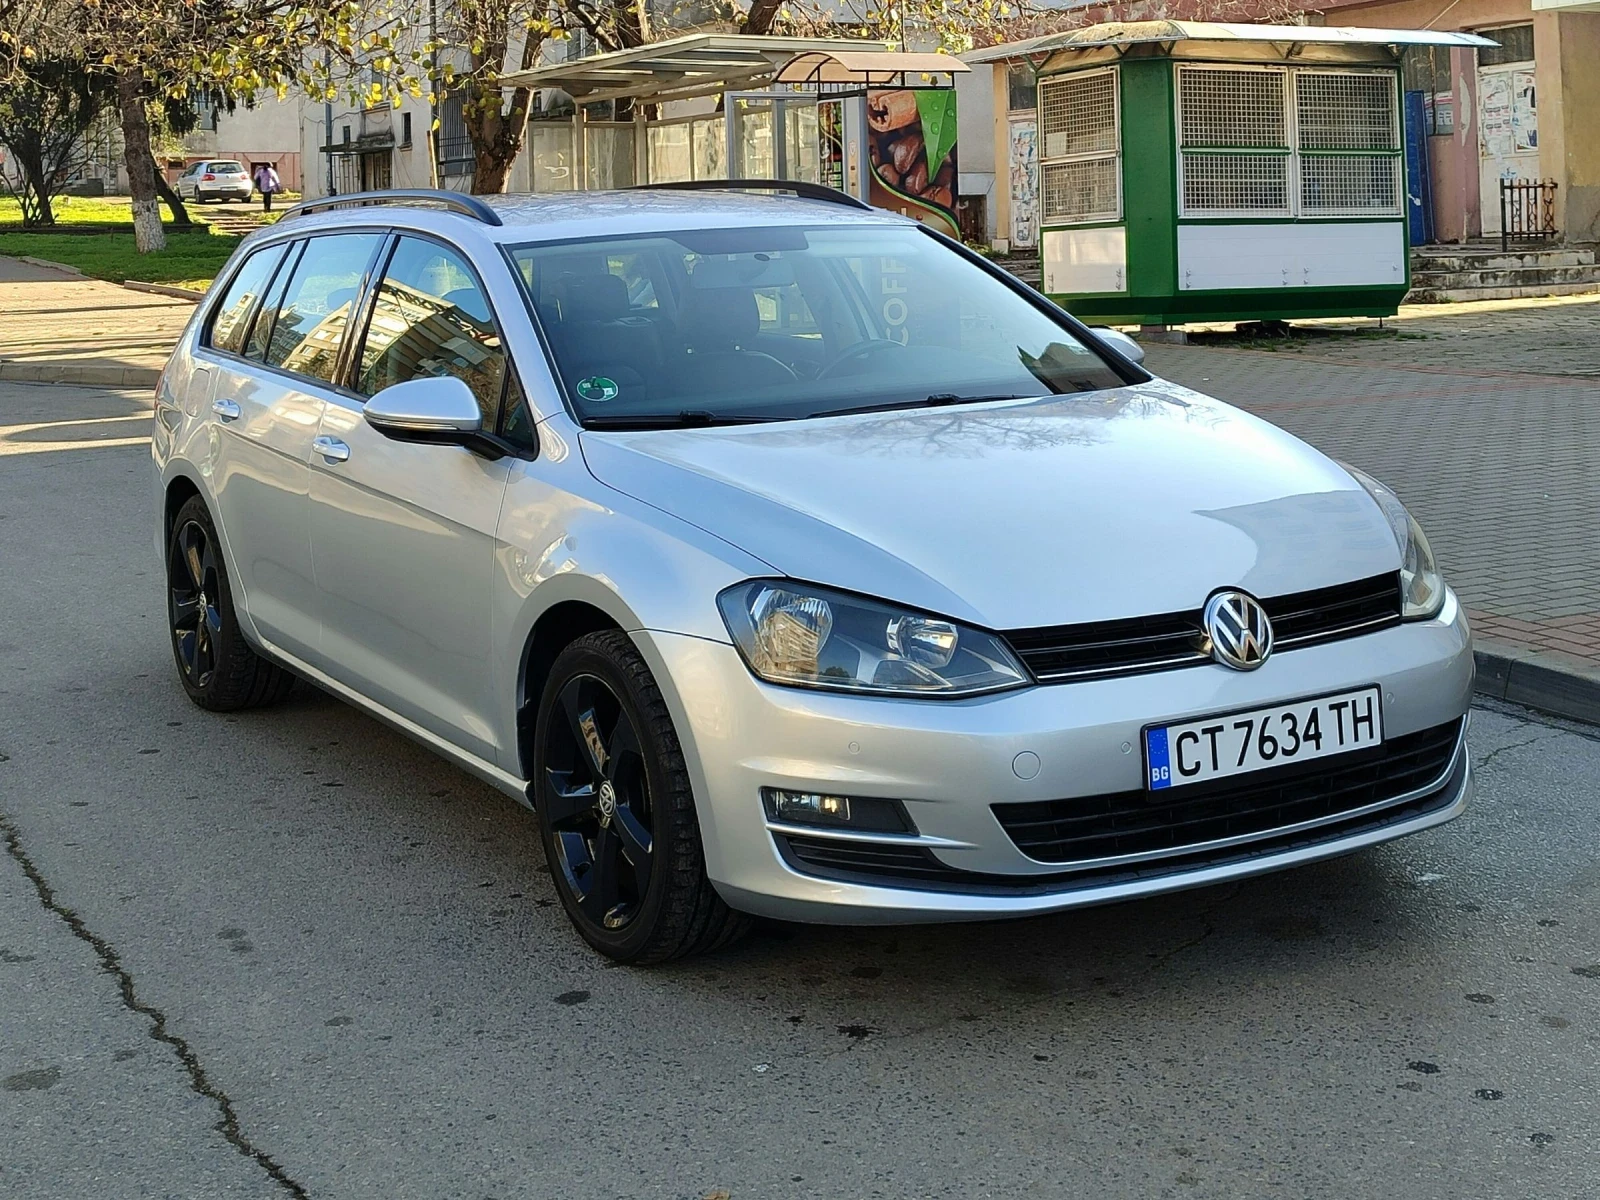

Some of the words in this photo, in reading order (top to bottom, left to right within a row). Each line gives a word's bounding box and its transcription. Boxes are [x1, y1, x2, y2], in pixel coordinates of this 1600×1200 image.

[1175, 725, 1224, 777] CT
[1233, 706, 1323, 761] 7634
[1328, 696, 1375, 746] TH
[1152, 766, 1169, 781] BG
